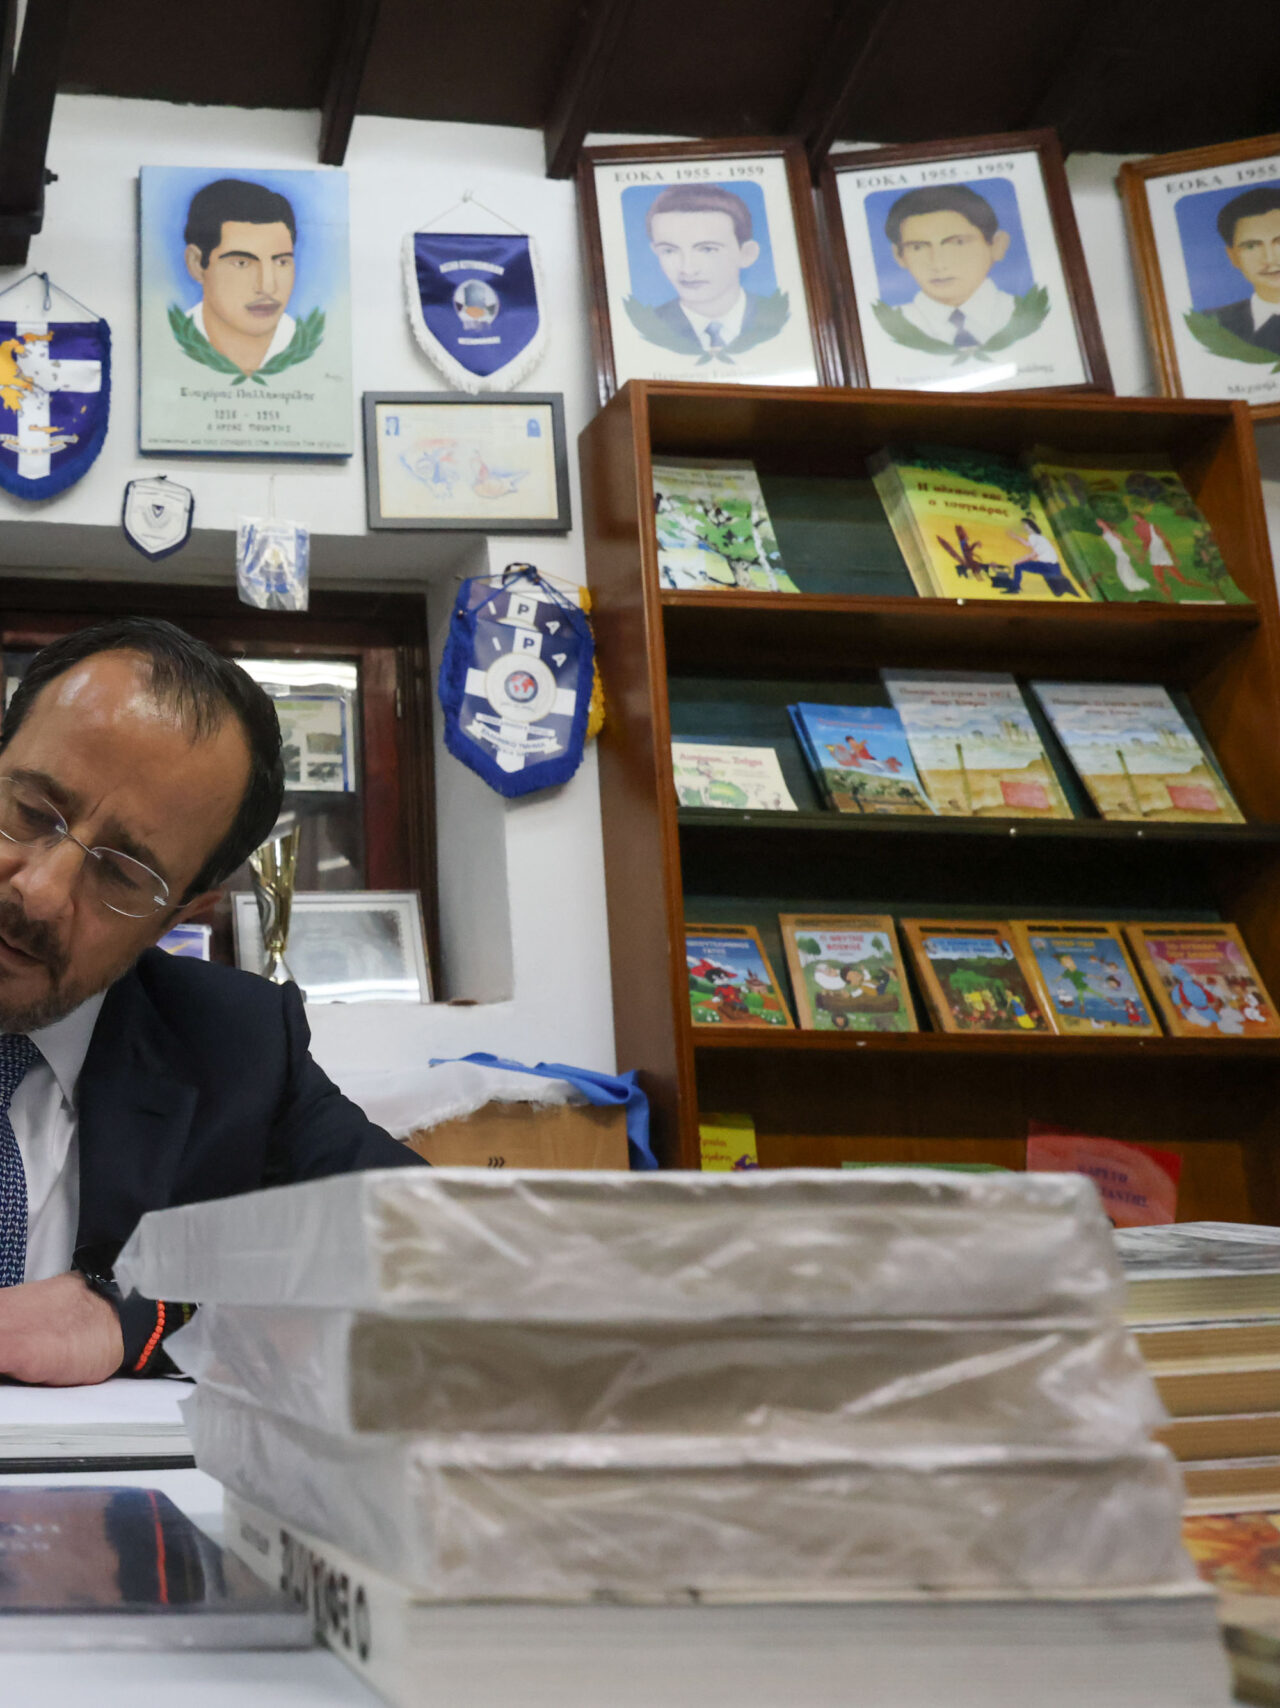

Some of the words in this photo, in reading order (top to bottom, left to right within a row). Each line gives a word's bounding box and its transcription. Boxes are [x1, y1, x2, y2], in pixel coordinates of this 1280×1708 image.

[676, 168, 710, 180] 1955
[729, 166, 765, 178] 1959
[921, 167, 958, 182] 1955
[976, 161, 1015, 175] 1959
